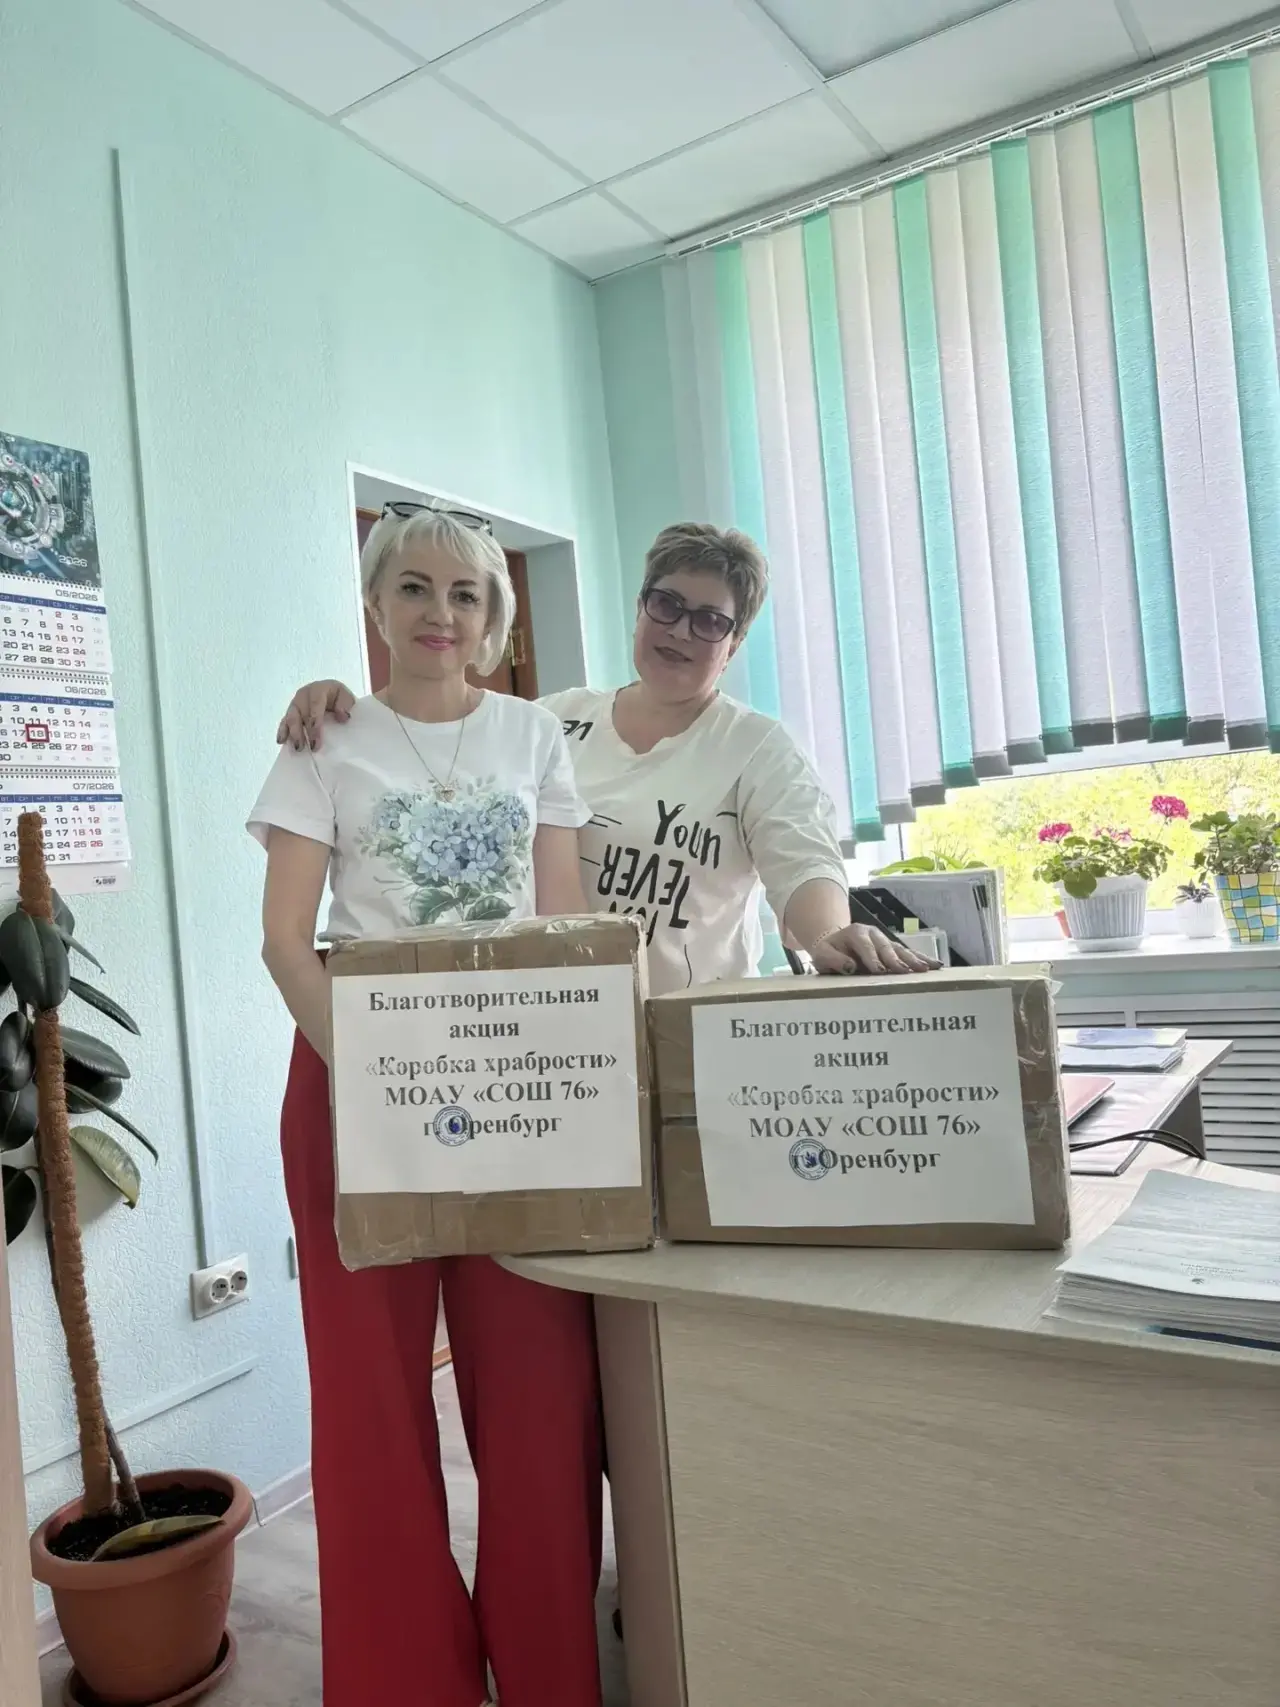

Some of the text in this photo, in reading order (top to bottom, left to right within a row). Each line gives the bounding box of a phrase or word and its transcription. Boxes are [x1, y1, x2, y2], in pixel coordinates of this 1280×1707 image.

[59, 555, 88, 567] 2026
[56, 589, 98, 601] 05/2026
[2, 629, 16, 637] 13
[20, 630, 34, 639] 14
[38, 632, 51, 640] 15
[3, 641, 18, 649] 20
[40, 656, 54, 664] 29
[65, 686, 106, 696] 06/2026
[369, 988, 600, 1012] Благотворительная
[449, 1022, 520, 1039] акция
[730, 1014, 978, 1040] Благотворительная
[365, 1051, 617, 1080] «Коробка храбрости»
[814, 1051, 889, 1070] акция
[384, 1080, 600, 1106] МОАУ «СОШ 76»
[726, 1082, 1000, 1110] «Коробка храбрости»
[448, 1114, 562, 1140] Оренбург
[750, 1114, 981, 1138] МОАУ «СОШ 76»
[818, 1148, 942, 1174] Оренбург
